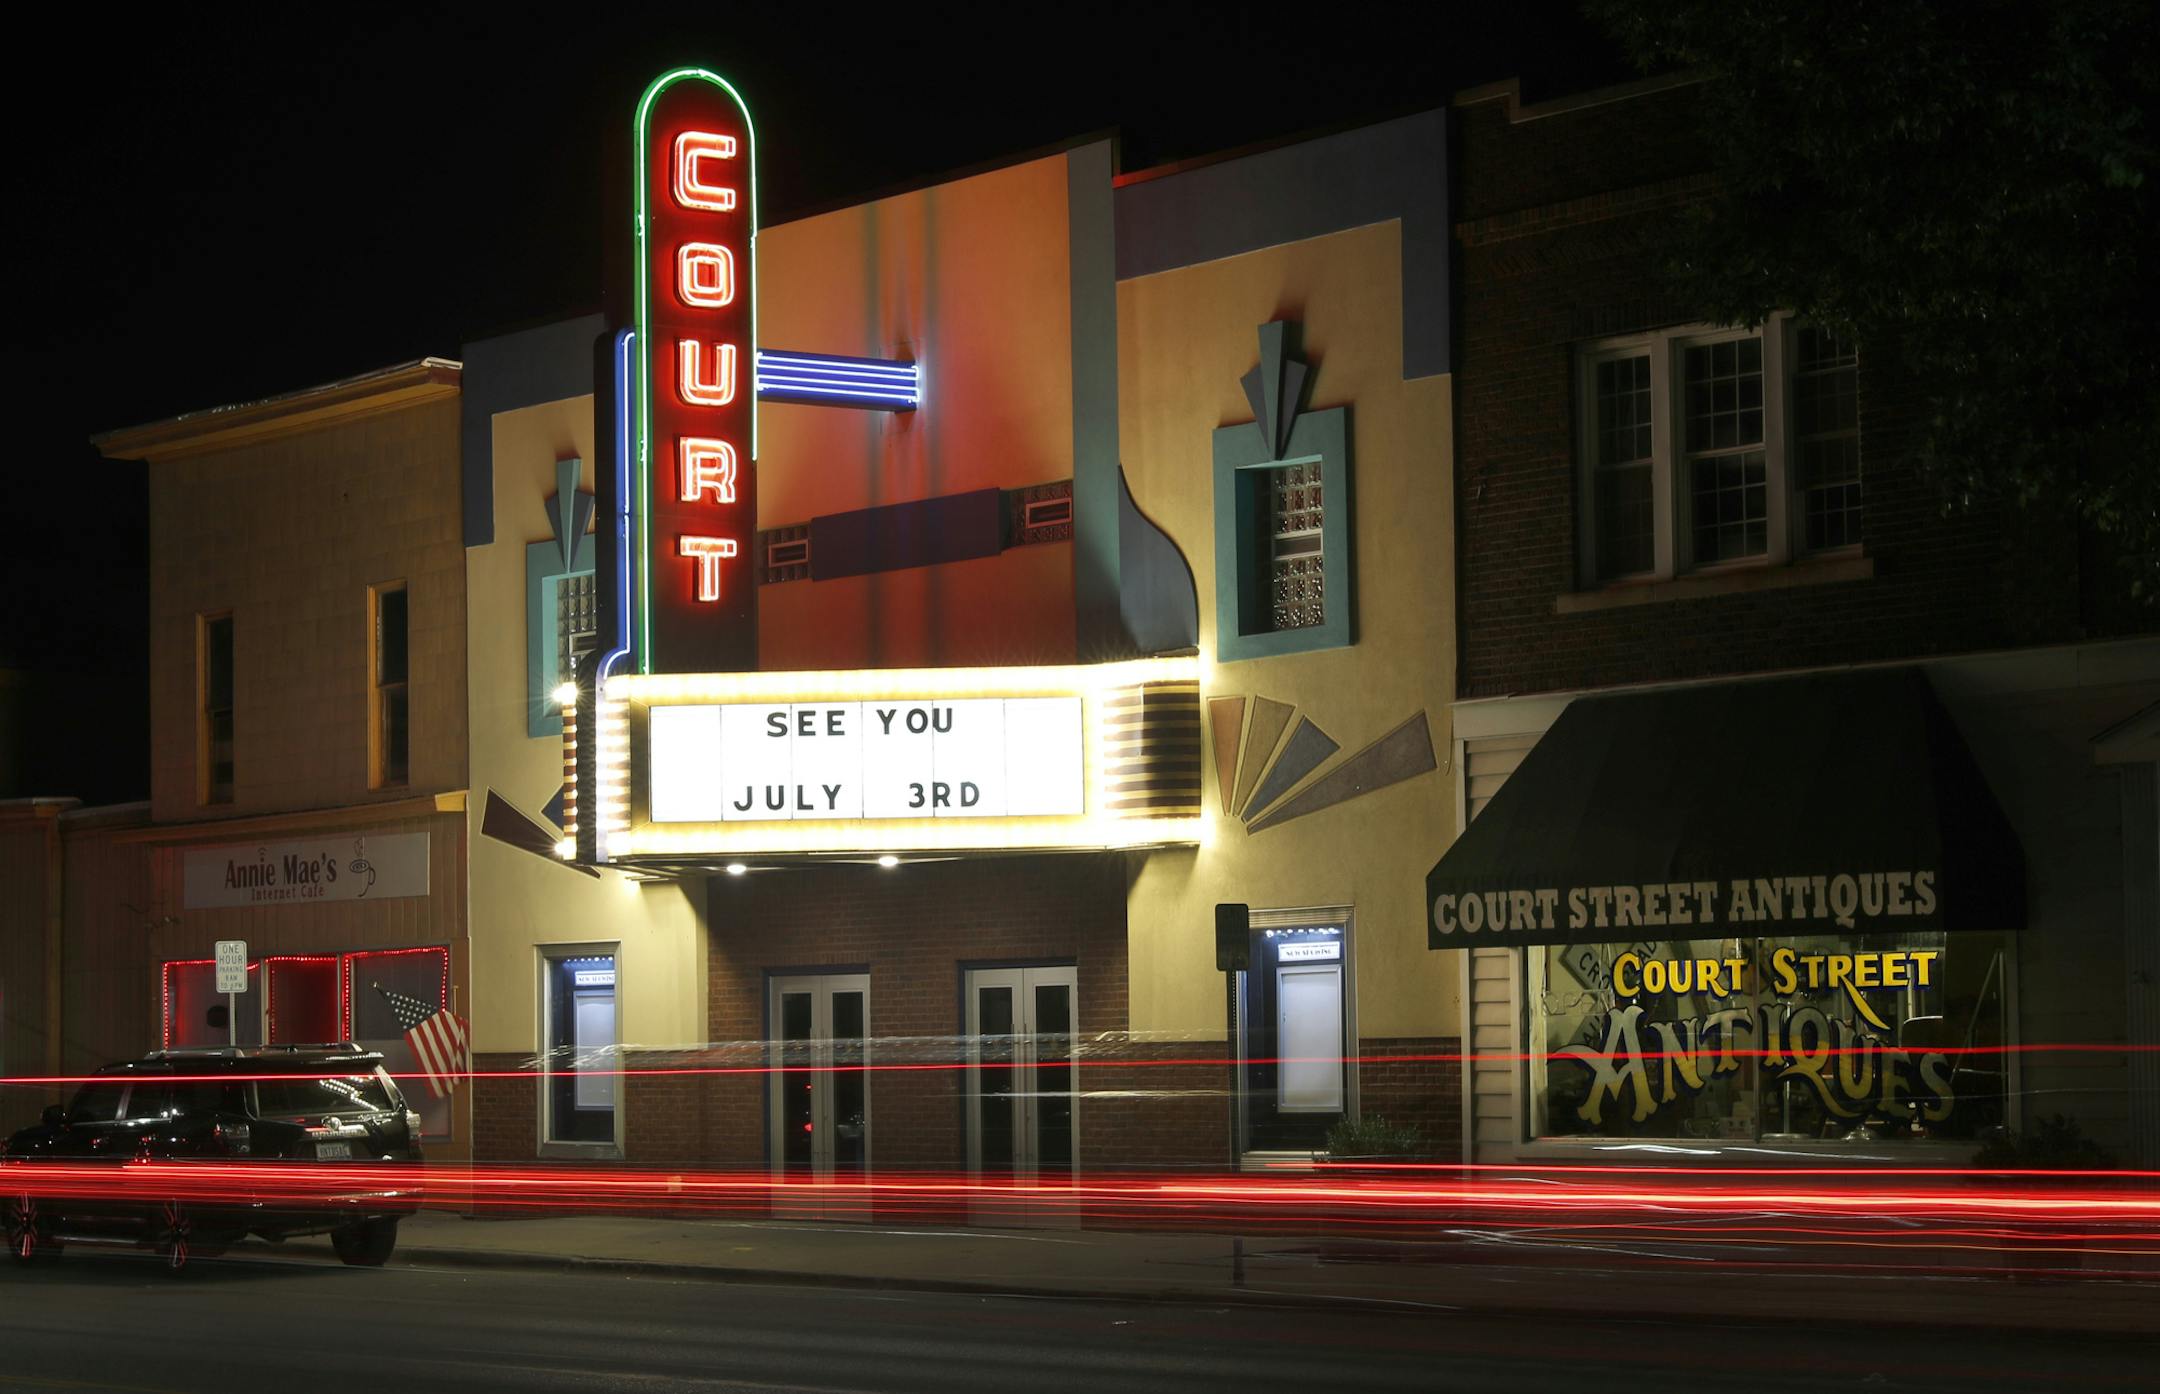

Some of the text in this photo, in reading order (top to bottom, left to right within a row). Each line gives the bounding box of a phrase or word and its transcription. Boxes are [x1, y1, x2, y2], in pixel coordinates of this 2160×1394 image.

[673, 130, 738, 603] COURT
[767, 708, 953, 738] SEE YOU
[733, 781, 980, 811] JULY 3RD
[224, 852, 337, 888] Annie Mae's
[251, 887, 296, 901] Internet
[1433, 871, 1937, 934] COURT STREET ANTIQUES
[219, 955, 243, 964] HOUR
[222, 945, 240, 954] ONE
[1613, 947, 1939, 1031] COURT STREET
[1547, 1003, 1955, 1126] ANTIQUES
